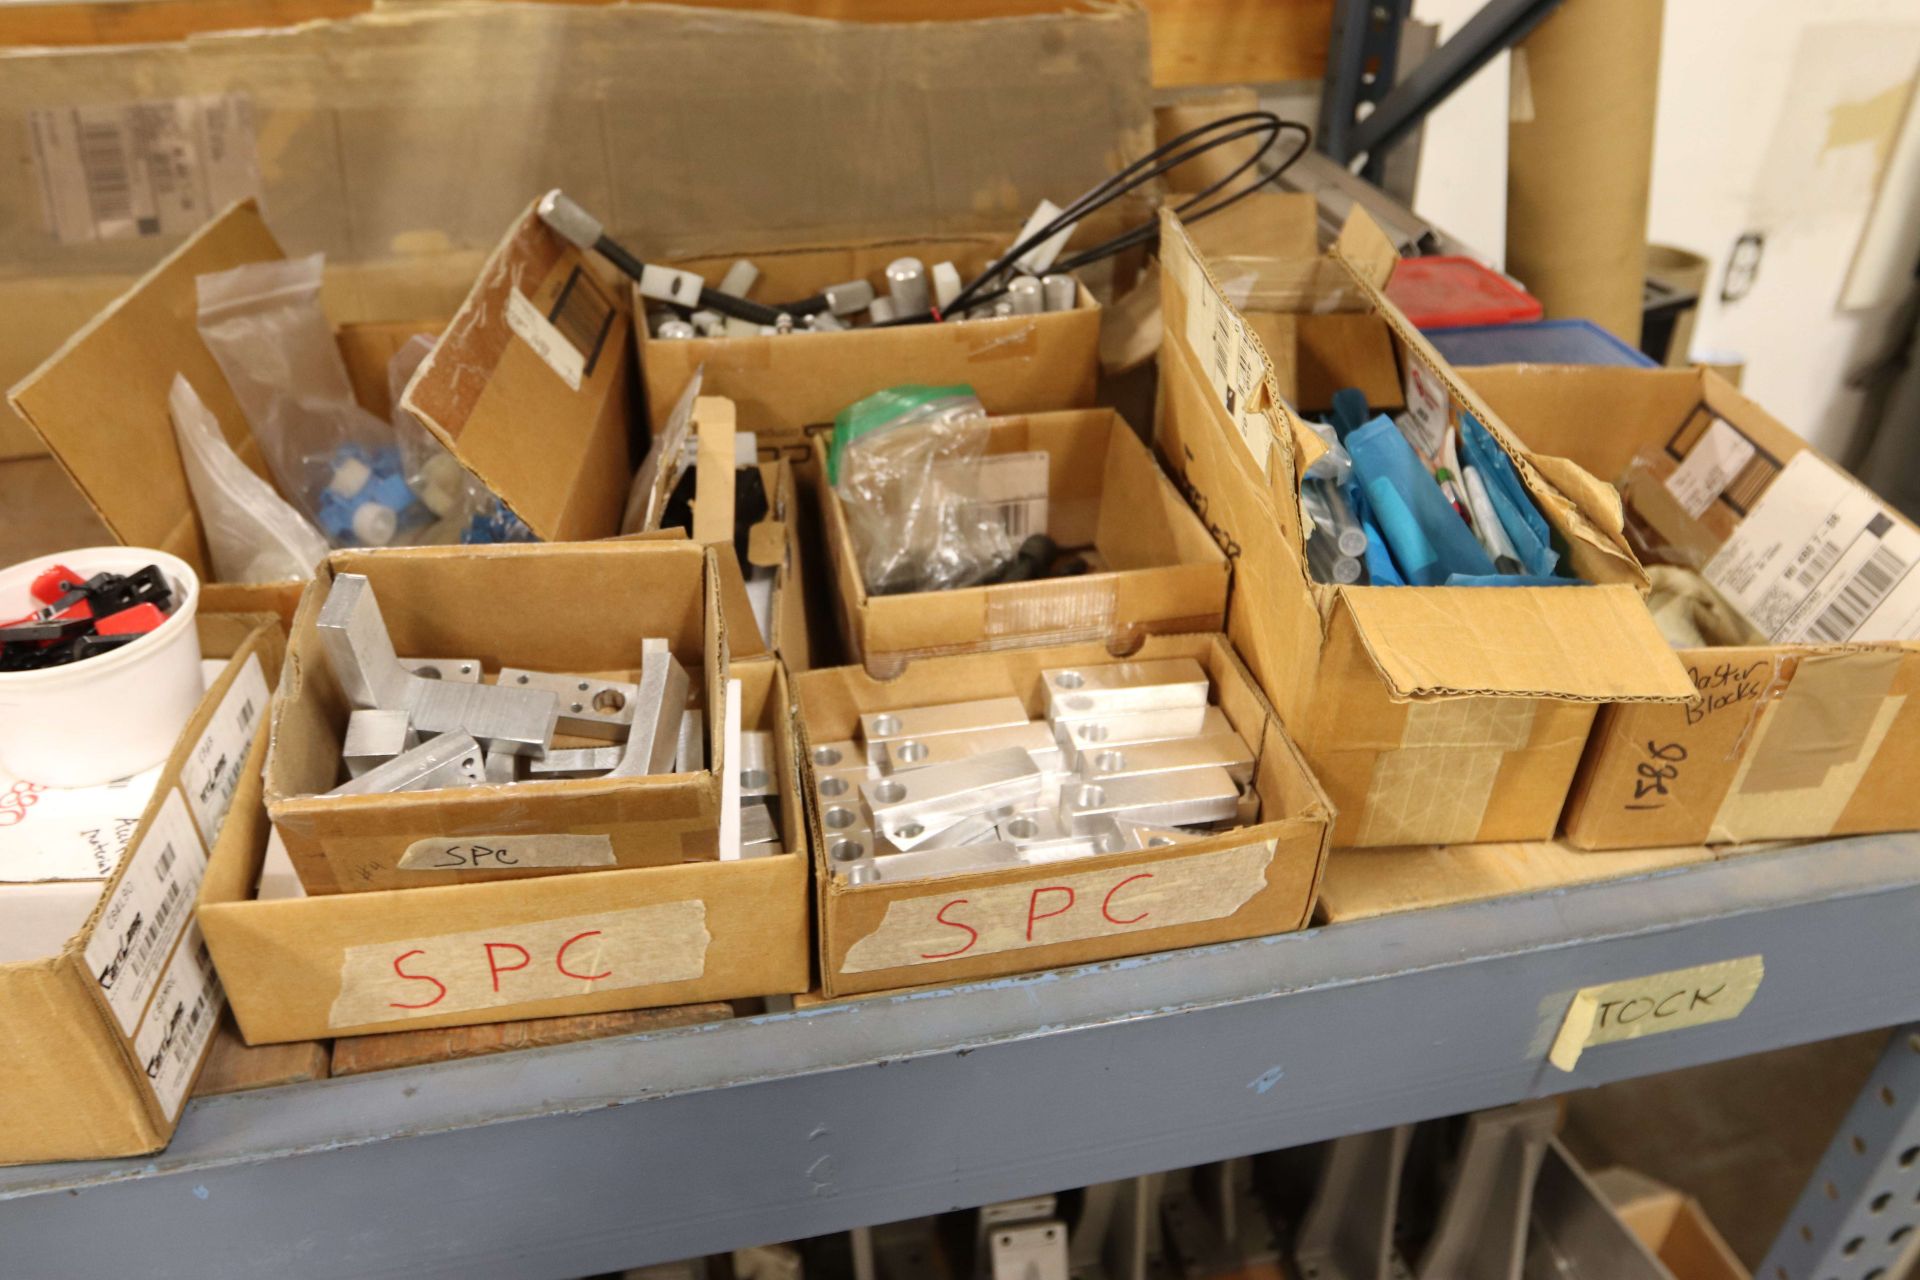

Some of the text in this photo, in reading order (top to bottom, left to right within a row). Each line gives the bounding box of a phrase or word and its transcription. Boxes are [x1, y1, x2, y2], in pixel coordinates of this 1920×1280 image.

[1686, 681, 1761, 726] Blocks
[433, 845, 519, 868] SPC
[921, 873, 1154, 959] SPC
[389, 930, 612, 1009] SPC
[1600, 983, 1727, 1029] TOCK
